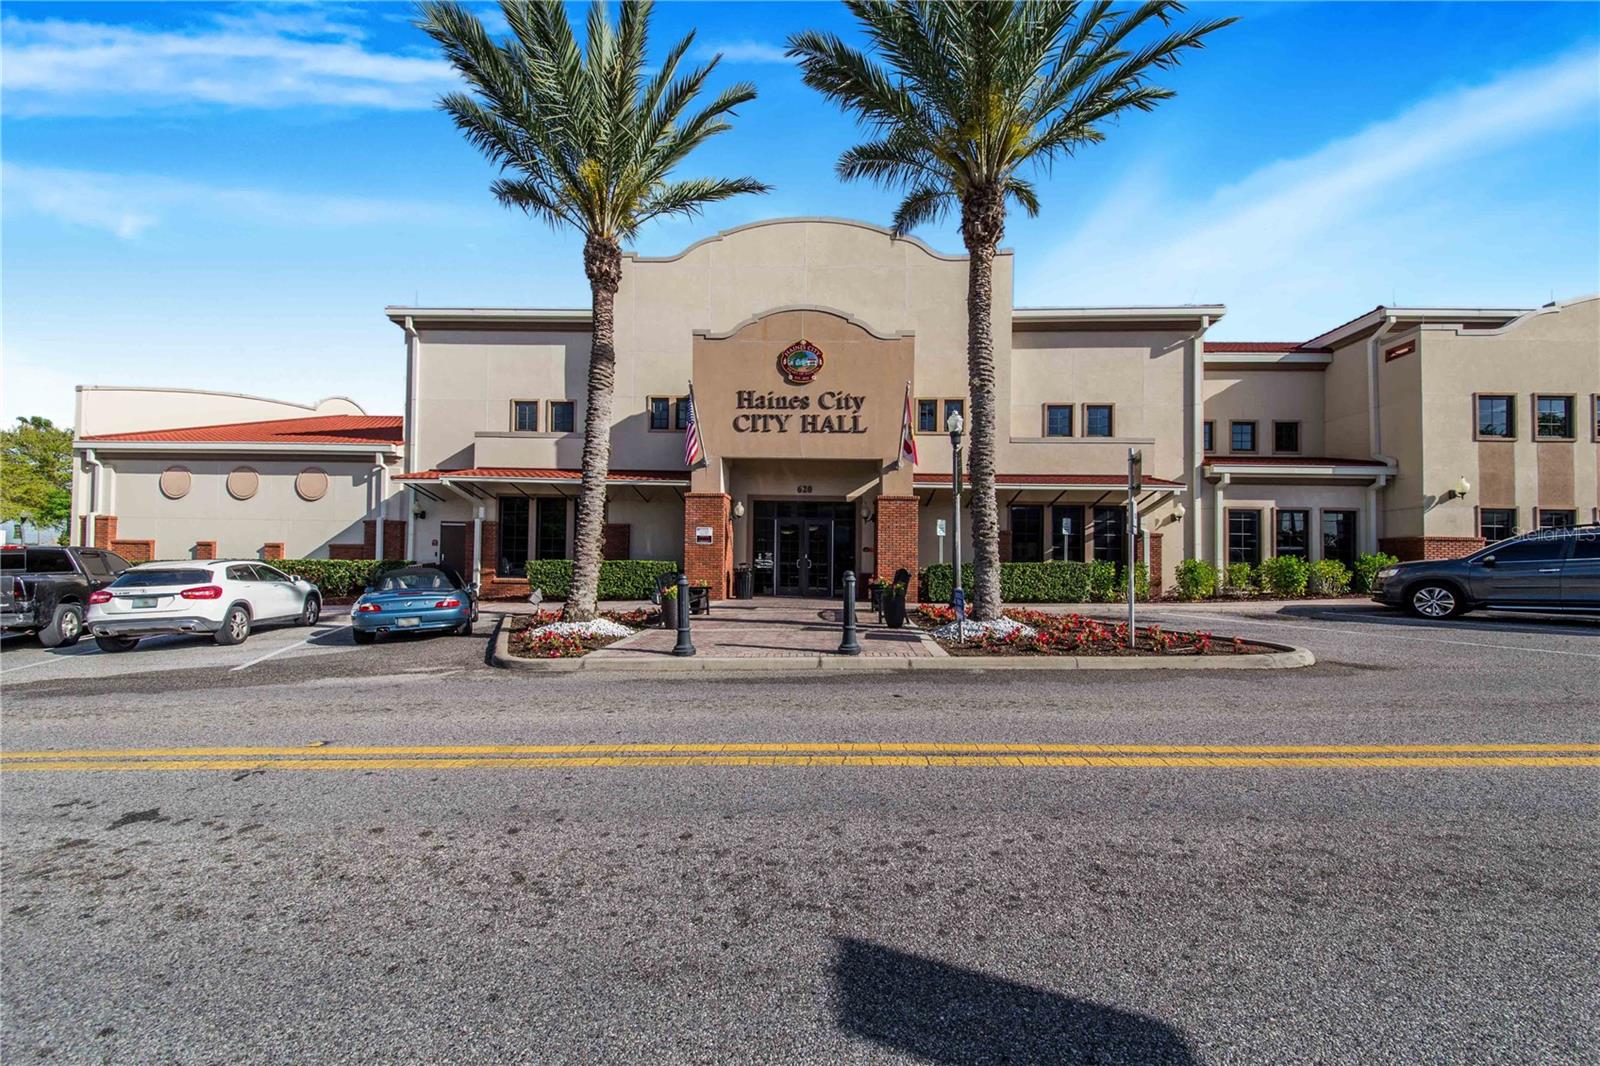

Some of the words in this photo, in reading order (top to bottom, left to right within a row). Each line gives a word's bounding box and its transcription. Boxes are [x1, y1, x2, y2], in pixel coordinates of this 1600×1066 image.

[784, 345, 806, 357] HAINES
[807, 345, 821, 356] CITY
[736, 390, 810, 410] Haines
[817, 391, 866, 413] City
[733, 414, 793, 433] CITY
[800, 414, 868, 434] HALL
[797, 485, 813, 494] 620
